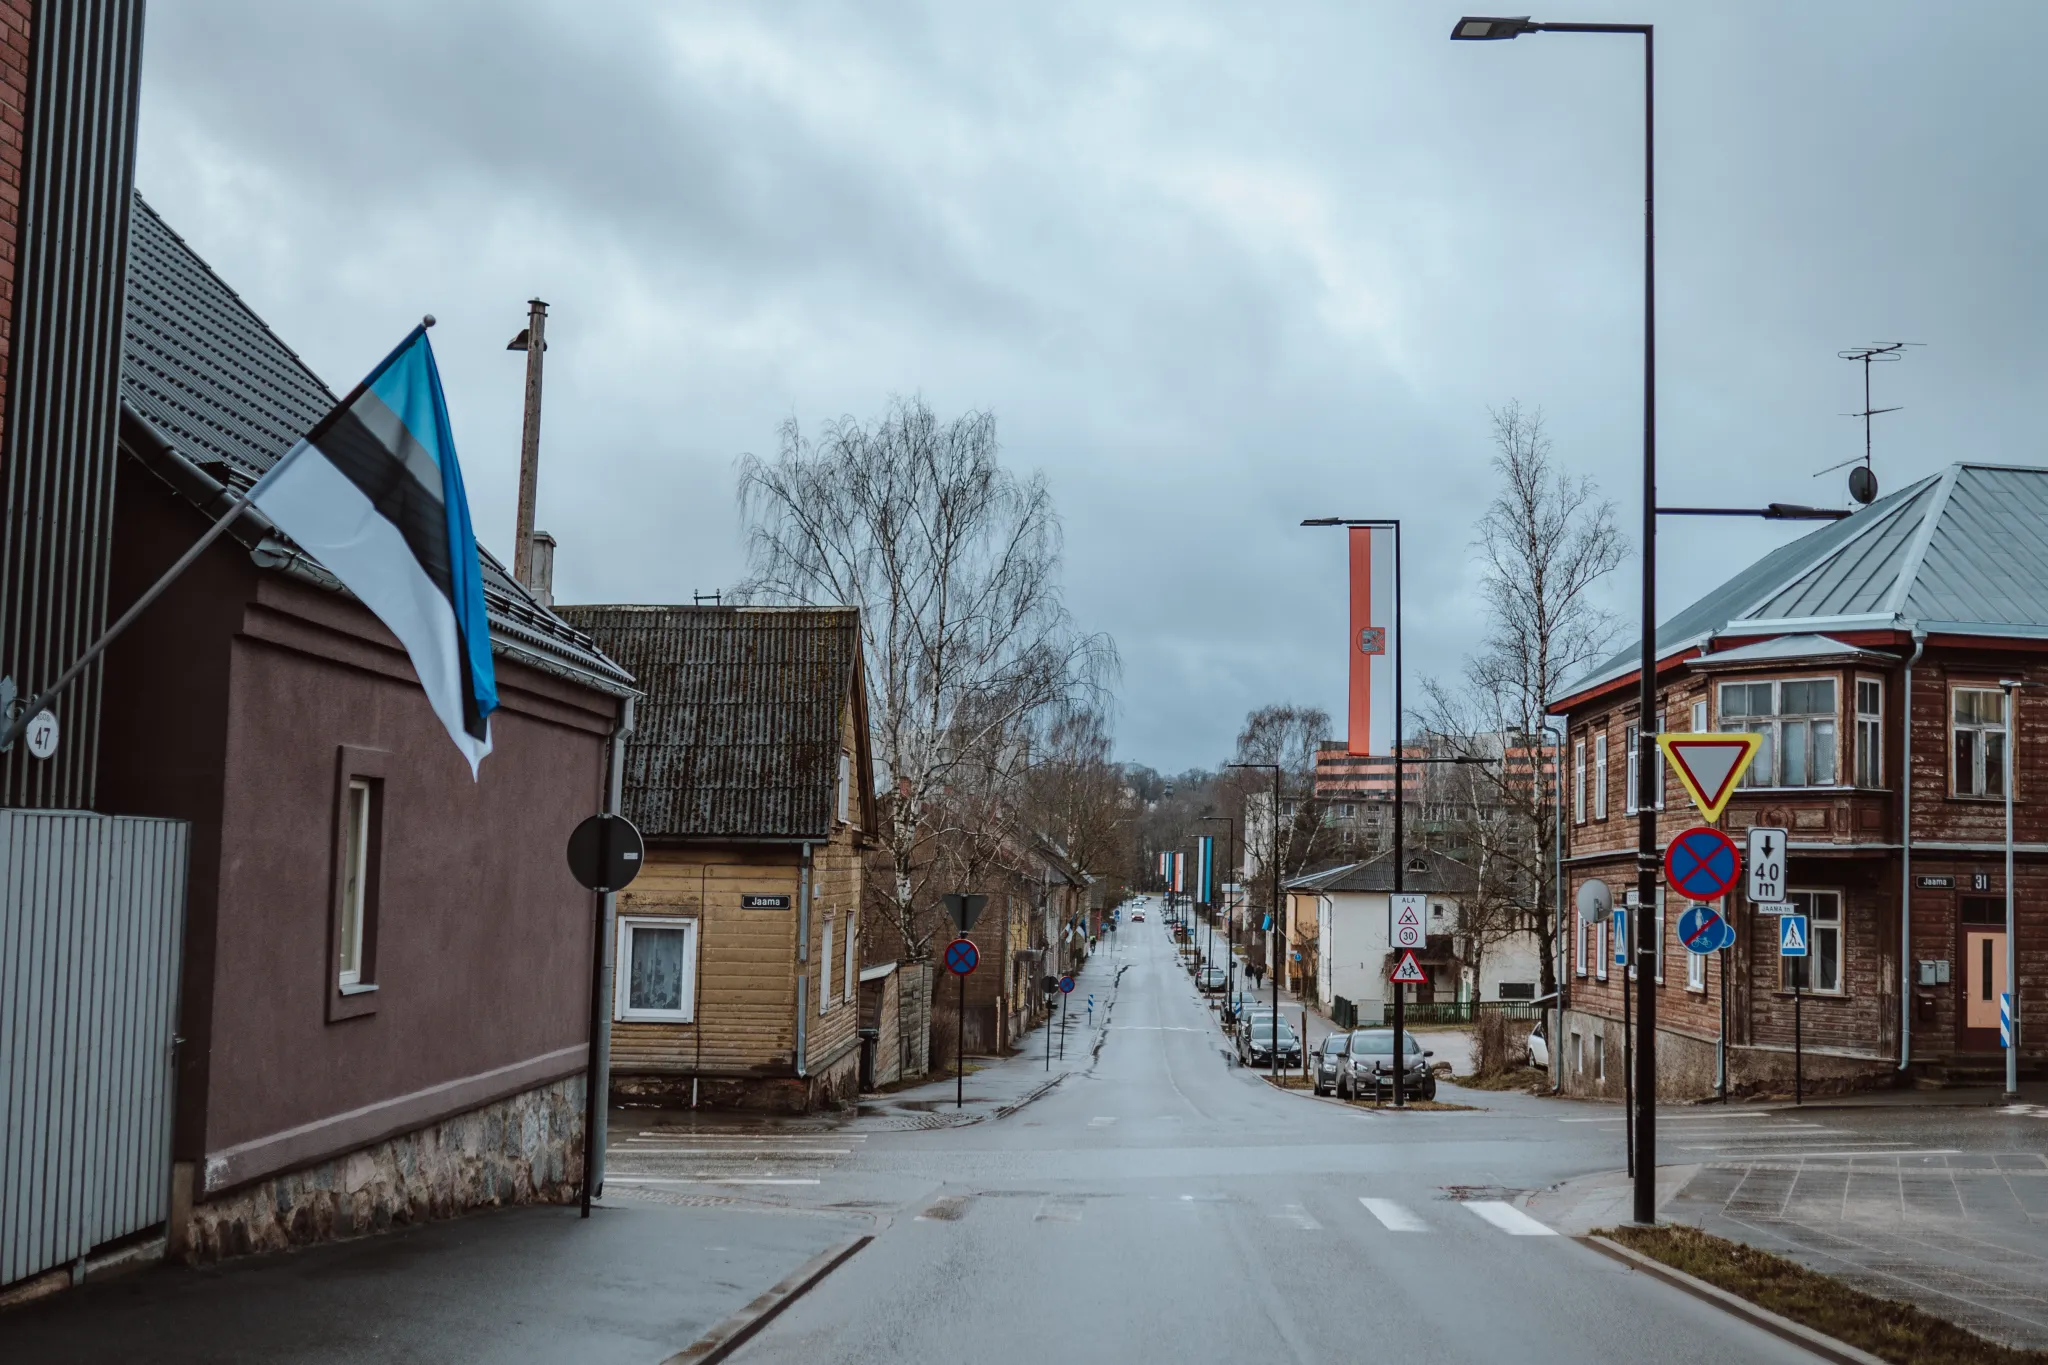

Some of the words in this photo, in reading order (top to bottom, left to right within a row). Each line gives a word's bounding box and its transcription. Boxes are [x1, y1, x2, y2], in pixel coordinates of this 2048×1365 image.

[35, 727, 51, 750] 47
[1755, 863, 1779, 881] 40
[1923, 877, 1947, 886] Jaama
[1975, 874, 1987, 890] 31
[1758, 883, 1775, 897] m
[751, 897, 780, 906] Jaama
[1403, 931, 1414, 941] 30
